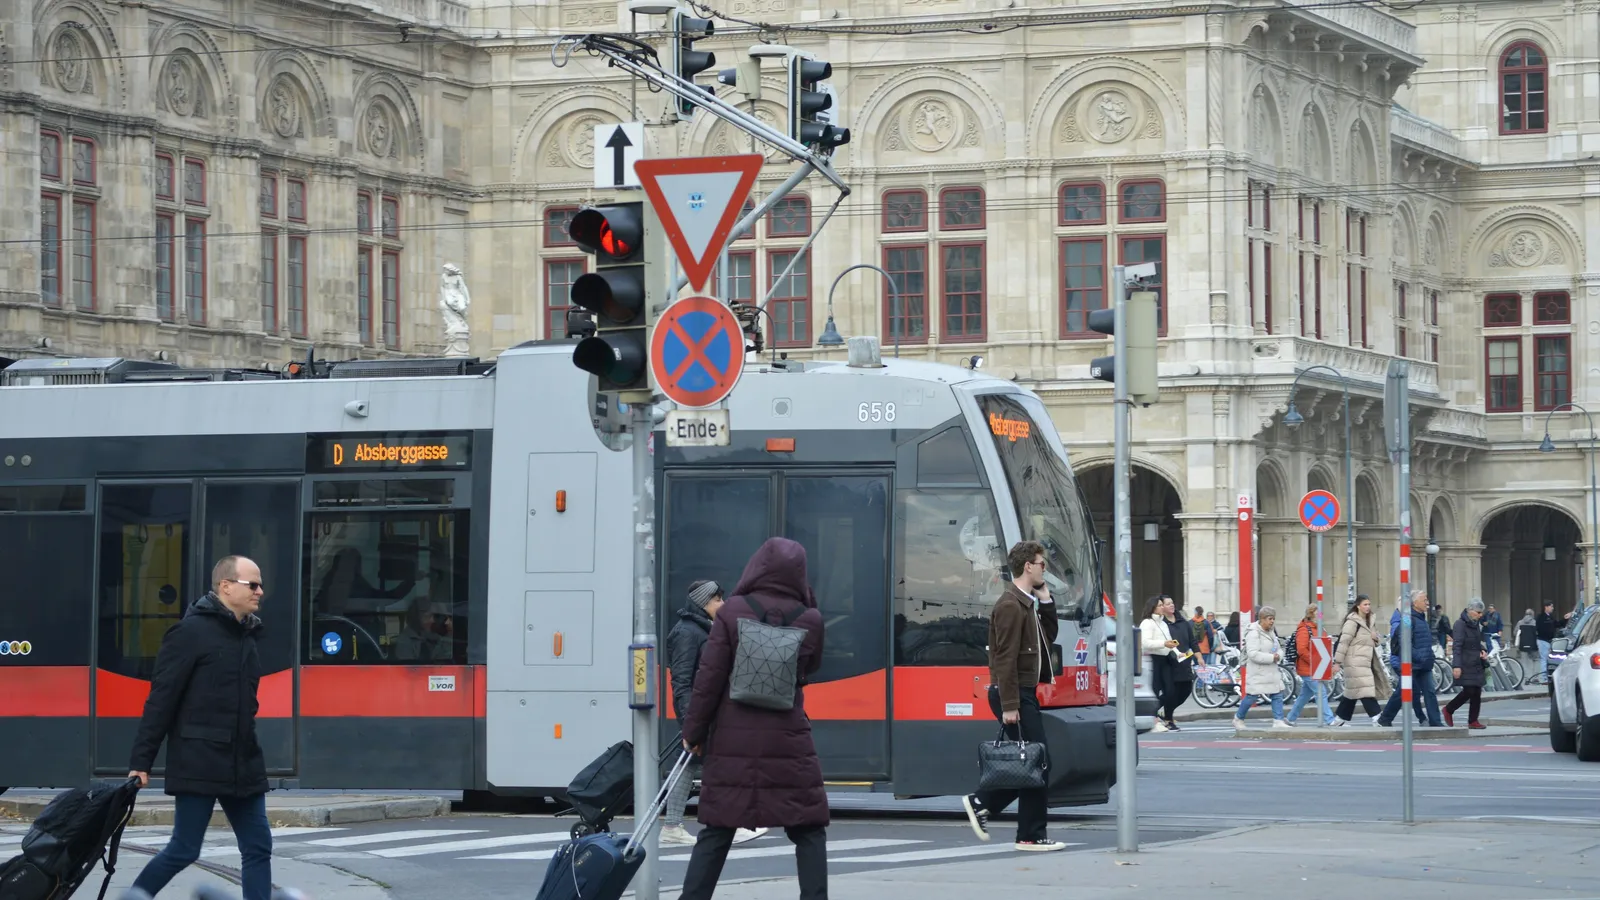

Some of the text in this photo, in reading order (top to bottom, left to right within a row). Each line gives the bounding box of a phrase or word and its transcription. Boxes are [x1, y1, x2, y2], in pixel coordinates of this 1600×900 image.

[858, 401, 896, 422] 658
[677, 418, 717, 438] Ende
[333, 443, 448, 465] D Absberggasse
[1076, 671, 1089, 691] 658
